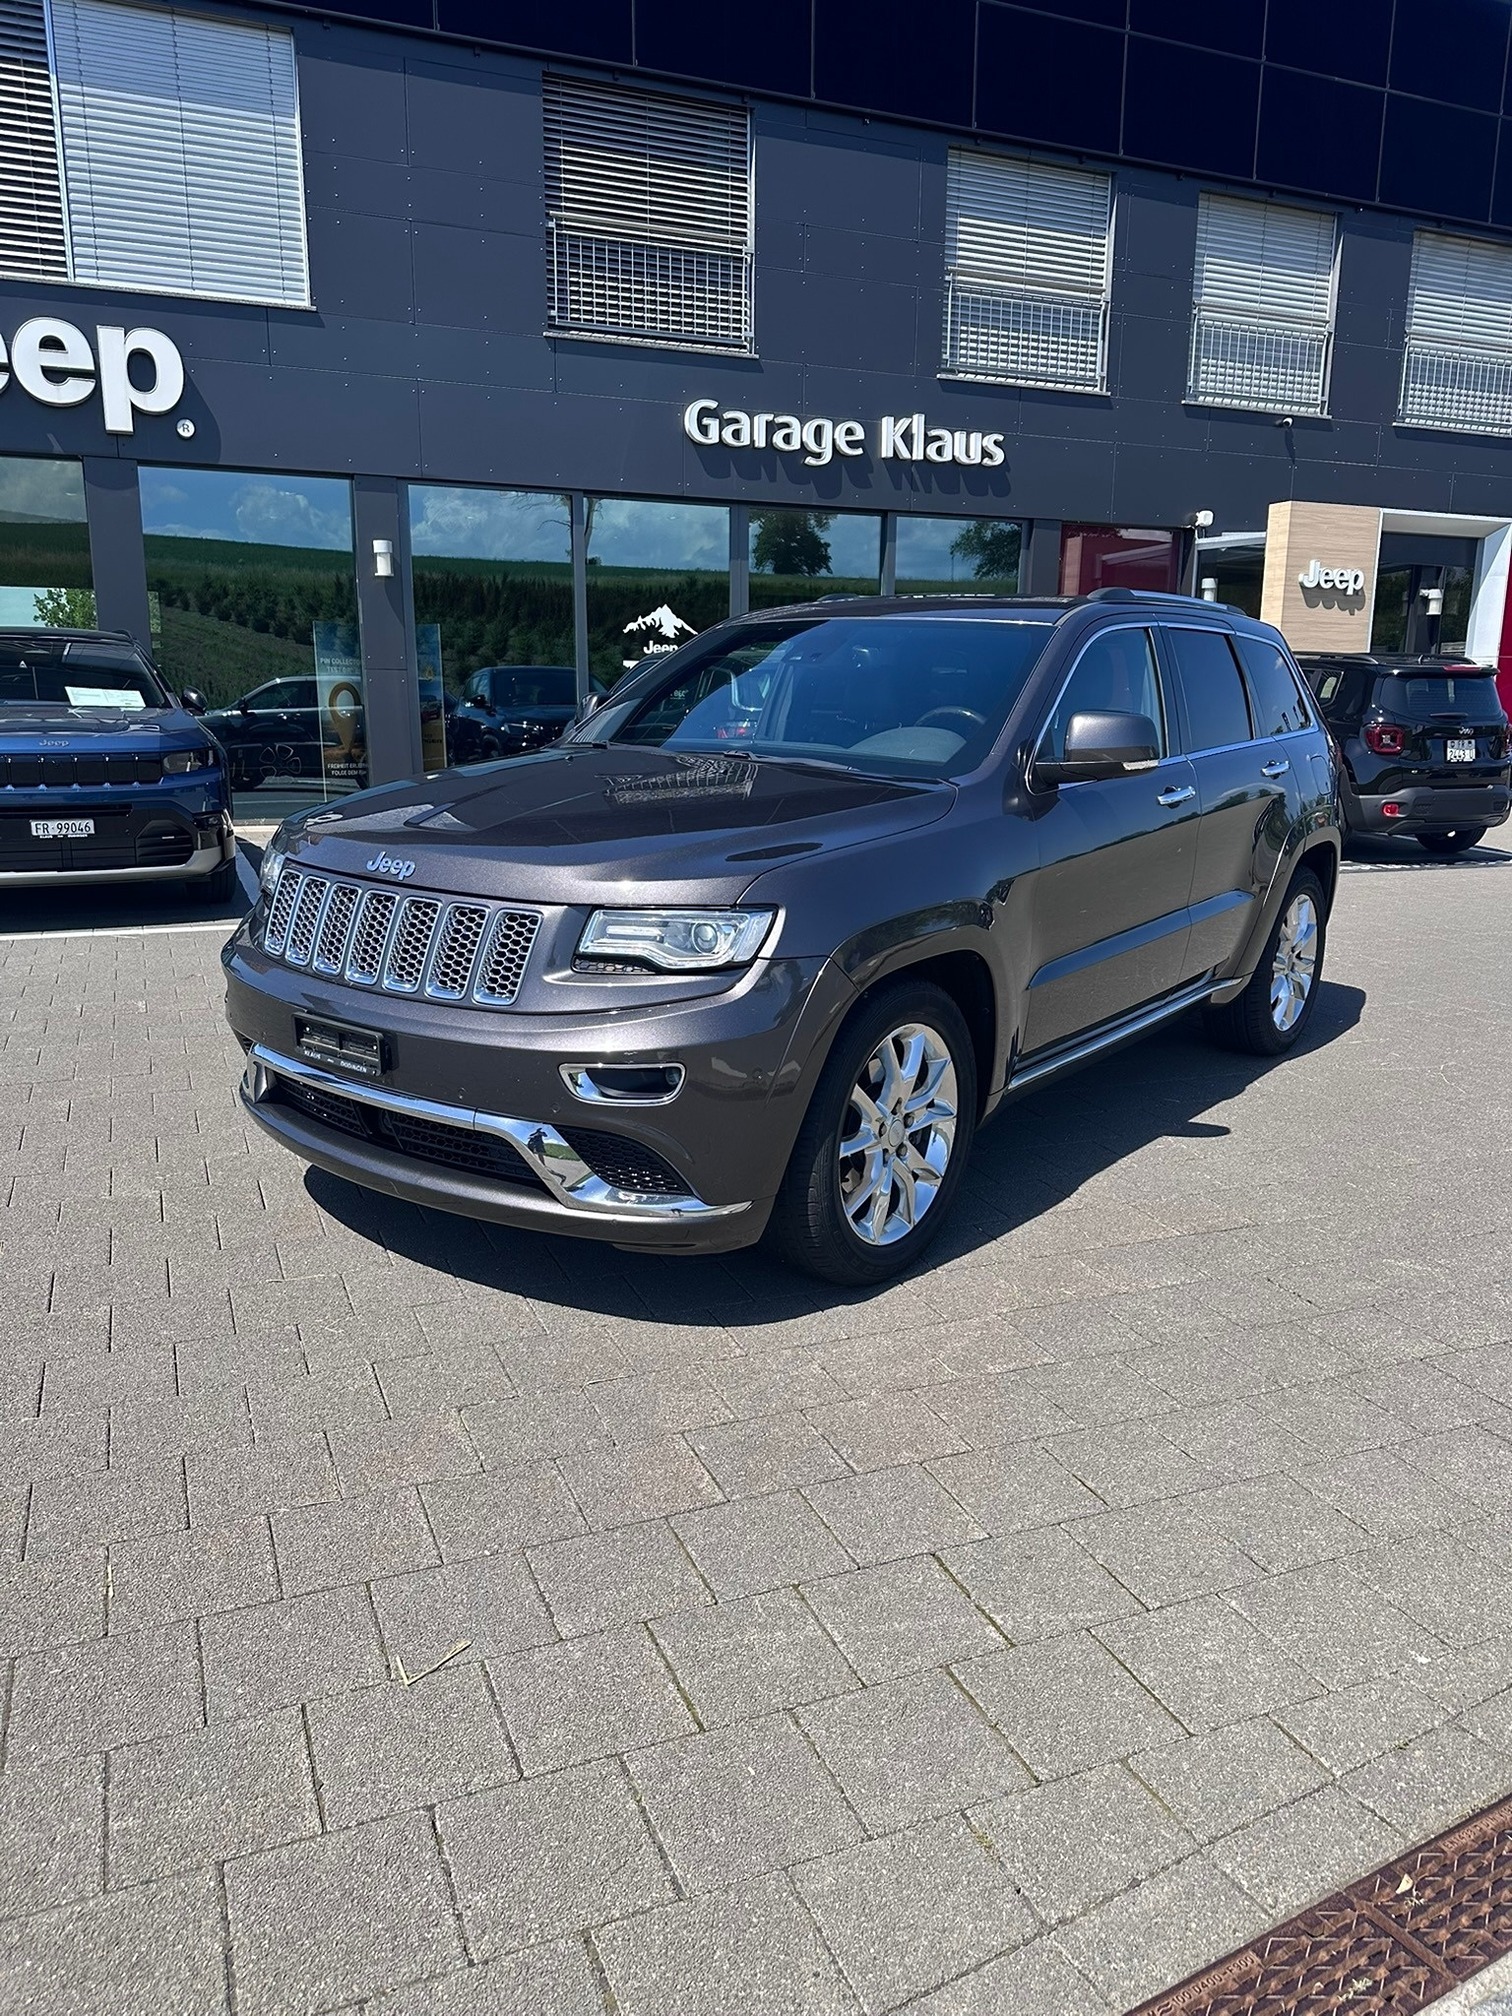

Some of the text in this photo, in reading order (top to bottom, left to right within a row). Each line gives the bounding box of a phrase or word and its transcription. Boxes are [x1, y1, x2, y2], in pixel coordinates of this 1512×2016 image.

[0, 316, 185, 434] ep
[684, 398, 1005, 467] Garage Klaus
[1298, 559, 1365, 595] Jeep
[39, 738, 70, 748] Jeep
[366, 851, 416, 881] Jeep
